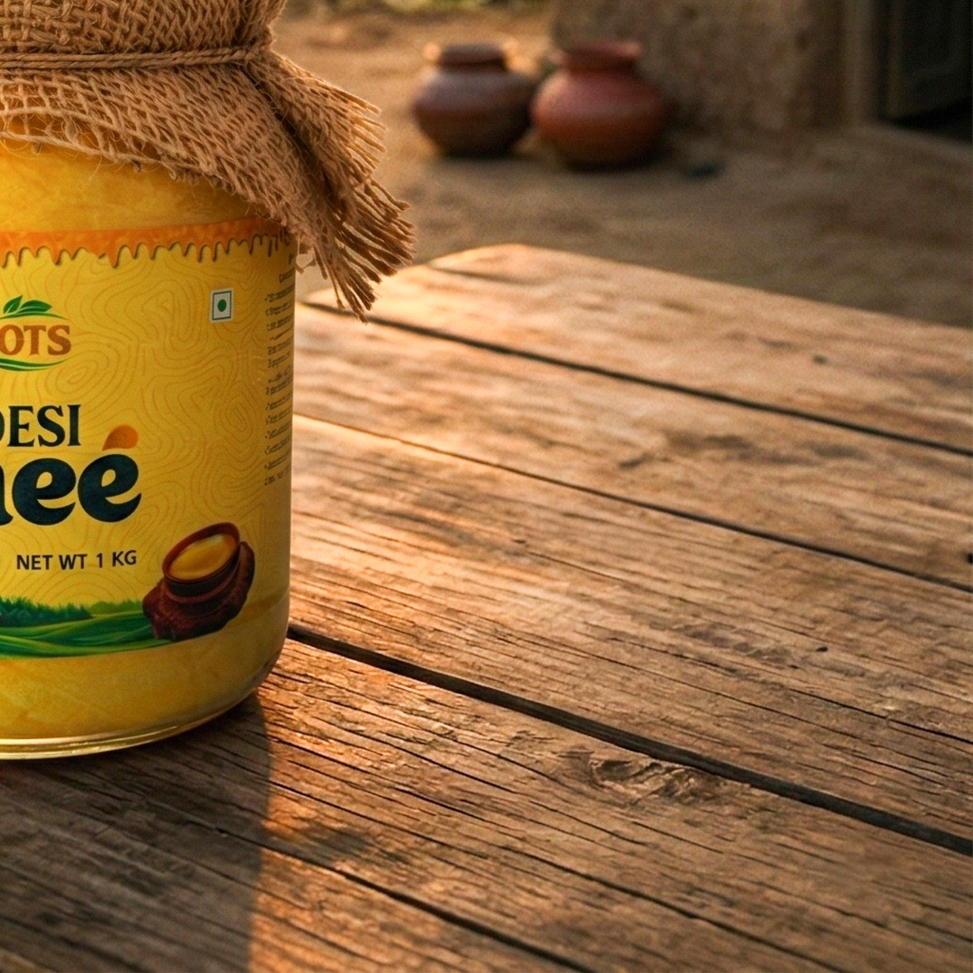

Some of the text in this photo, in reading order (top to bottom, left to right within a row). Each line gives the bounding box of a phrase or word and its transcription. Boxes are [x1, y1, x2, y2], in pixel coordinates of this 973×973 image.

[16, 550, 137, 570] NET WT 1 KG
